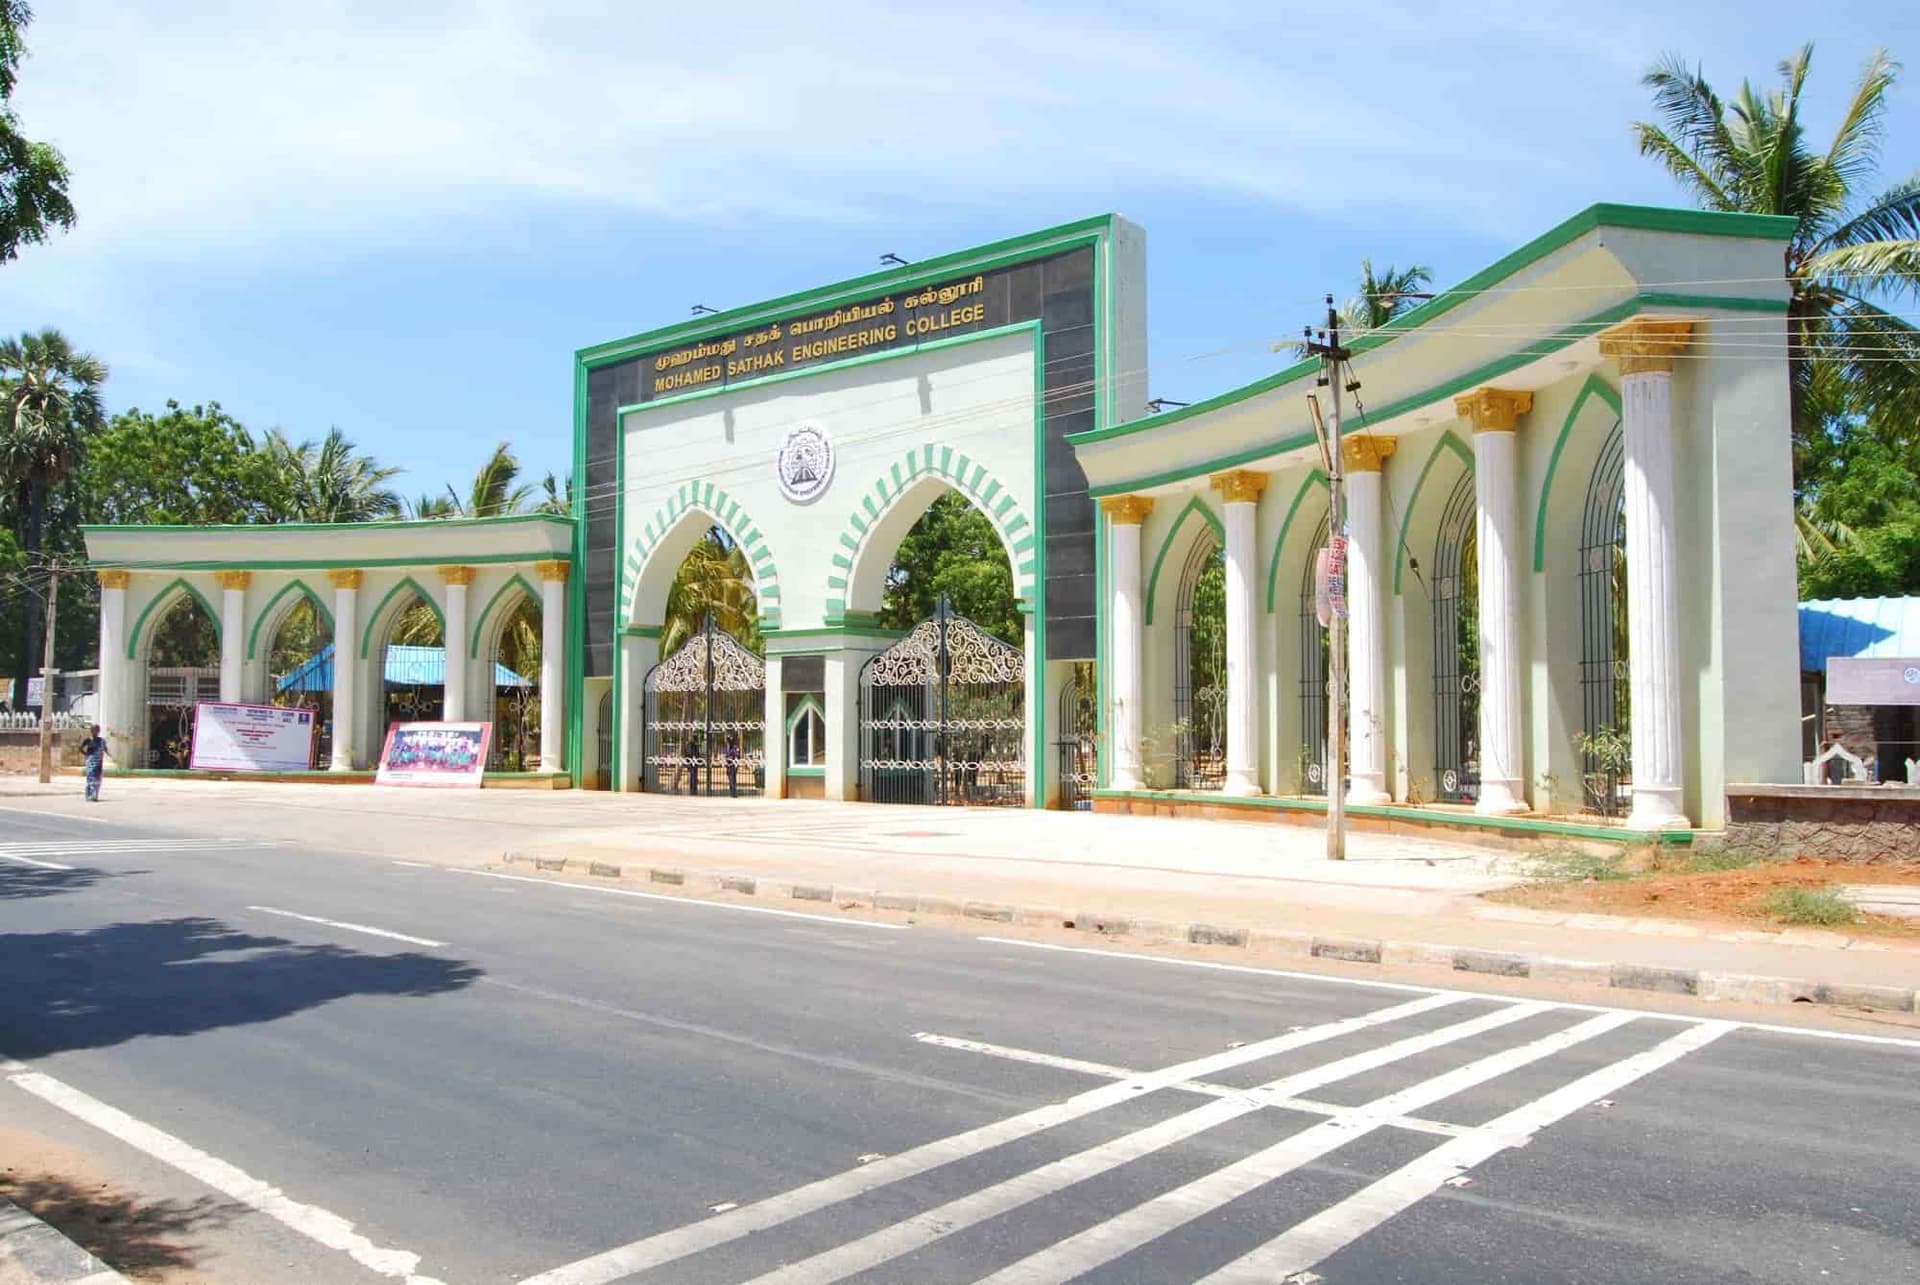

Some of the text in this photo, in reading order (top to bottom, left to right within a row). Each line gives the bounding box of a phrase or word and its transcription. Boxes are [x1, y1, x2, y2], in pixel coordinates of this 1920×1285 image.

[655, 303, 985, 392] MOHAMED SATHAK ENGINEERING COLLEGE
[744, 323, 782, 347] சதக்
[789, 296, 895, 336] பொறியியல்
[904, 275, 984, 309] கல்லூரி
